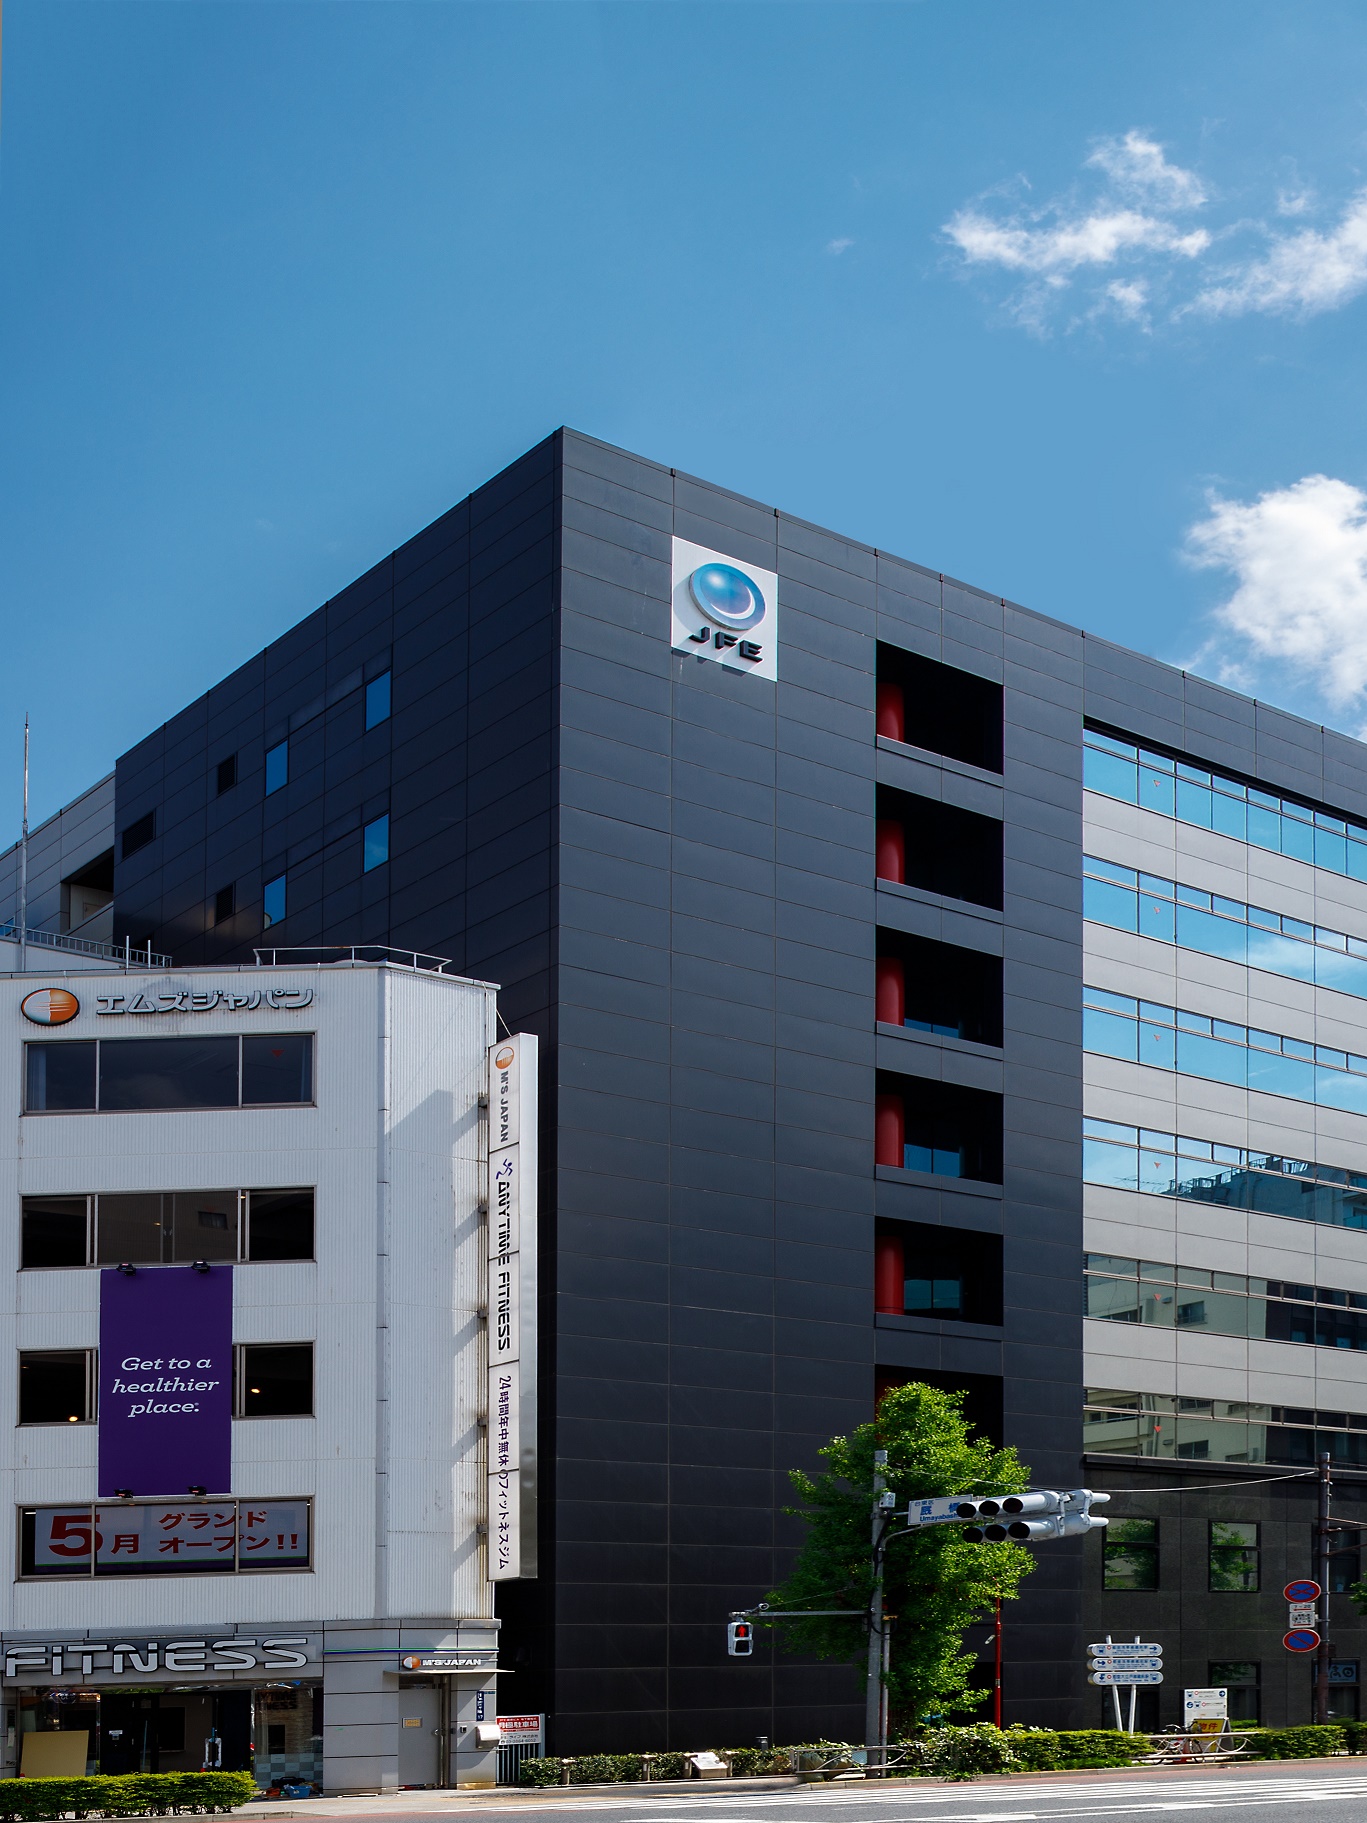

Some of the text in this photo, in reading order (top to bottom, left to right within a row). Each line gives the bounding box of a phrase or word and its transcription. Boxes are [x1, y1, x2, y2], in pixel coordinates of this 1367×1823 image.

[689, 626, 764, 663] JFE
[96, 988, 314, 1015] エムズジャパン
[500, 1070, 509, 1143] M'S JAPAN
[498, 1181, 511, 1266] ANYTIME
[121, 1357, 212, 1371] Get to a
[112, 1377, 220, 1394] healthier
[158, 1511, 267, 1531] グランド
[920, 1512, 959, 1522] Umayabash
[5, 1638, 308, 1678] FITNESS
